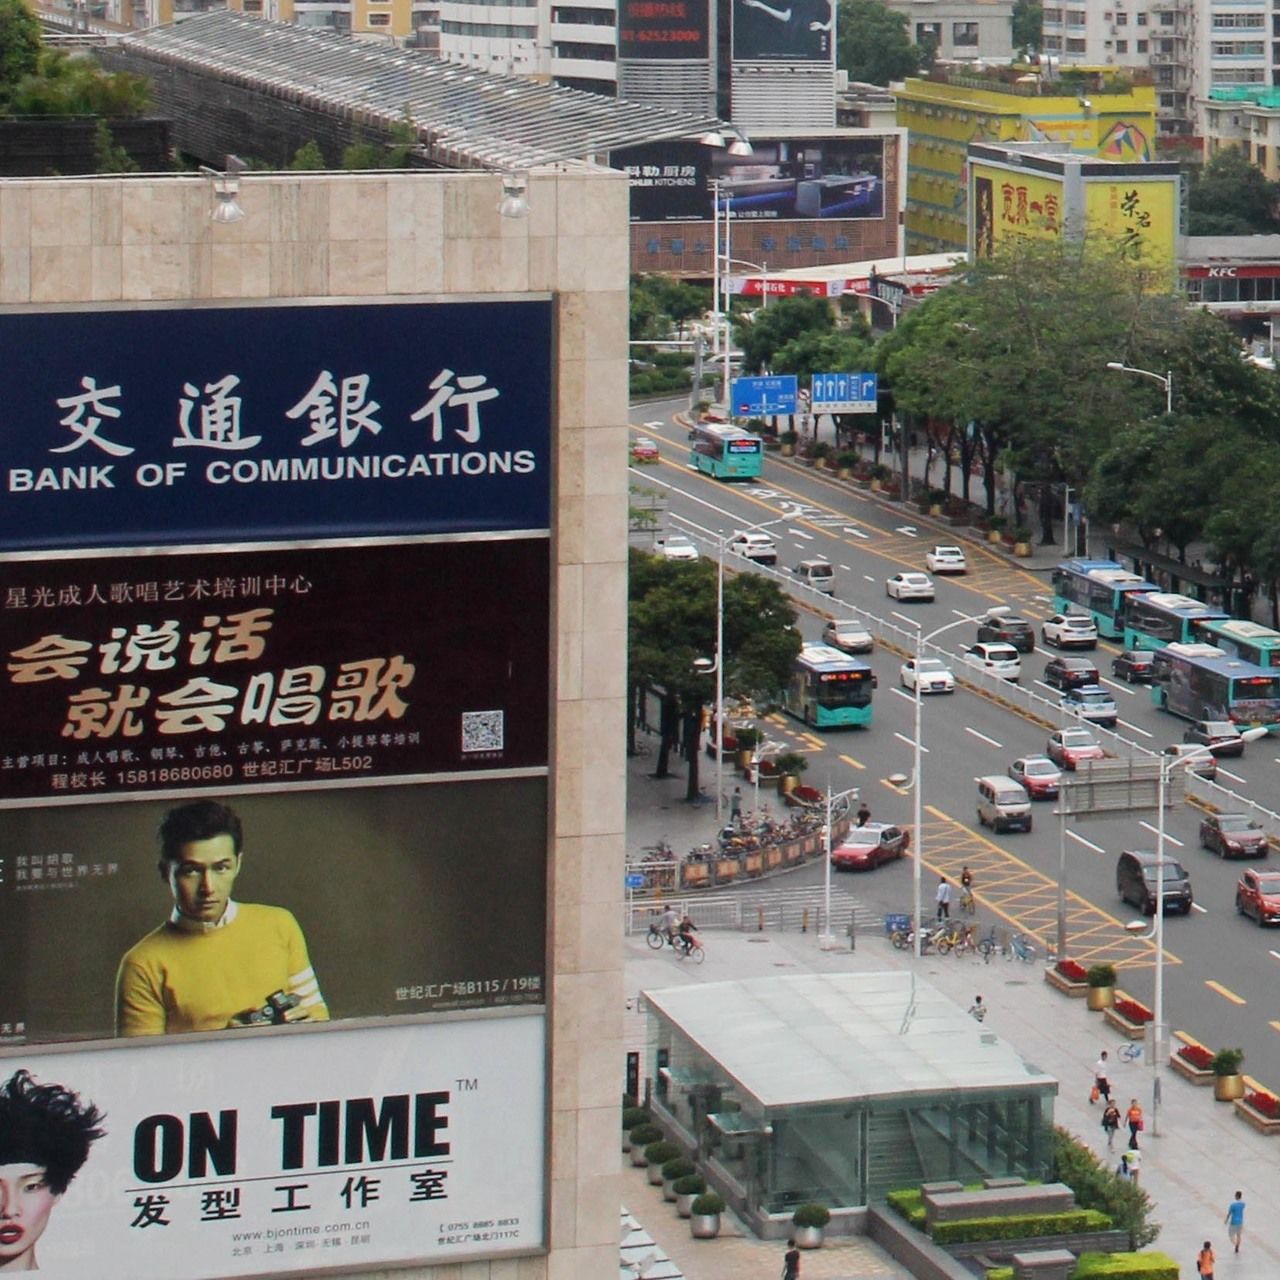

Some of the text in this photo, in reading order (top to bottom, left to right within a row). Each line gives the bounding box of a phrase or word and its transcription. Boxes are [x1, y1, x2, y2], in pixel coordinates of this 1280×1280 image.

[1208, 267, 1237, 277] KFC
[48, 369, 500, 458] 交通銀行
[9, 450, 536, 492] BANK OF COMMUNICATIONS
[5, 574, 313, 609] 星光成人歌唱艺术培训中心
[7, 607, 275, 683] 会说话
[61, 655, 416, 739] 就会唱歌
[117, 764, 233, 784] 15818680680
[243, 755, 373, 777] 世纪汇广场L502
[133, 1110, 237, 1183] ON
[271, 1091, 450, 1158] TIME
[131, 1170, 448, 1229] 发型工作室
[232, 1220, 371, 1242] www.bjontime.com.cn
